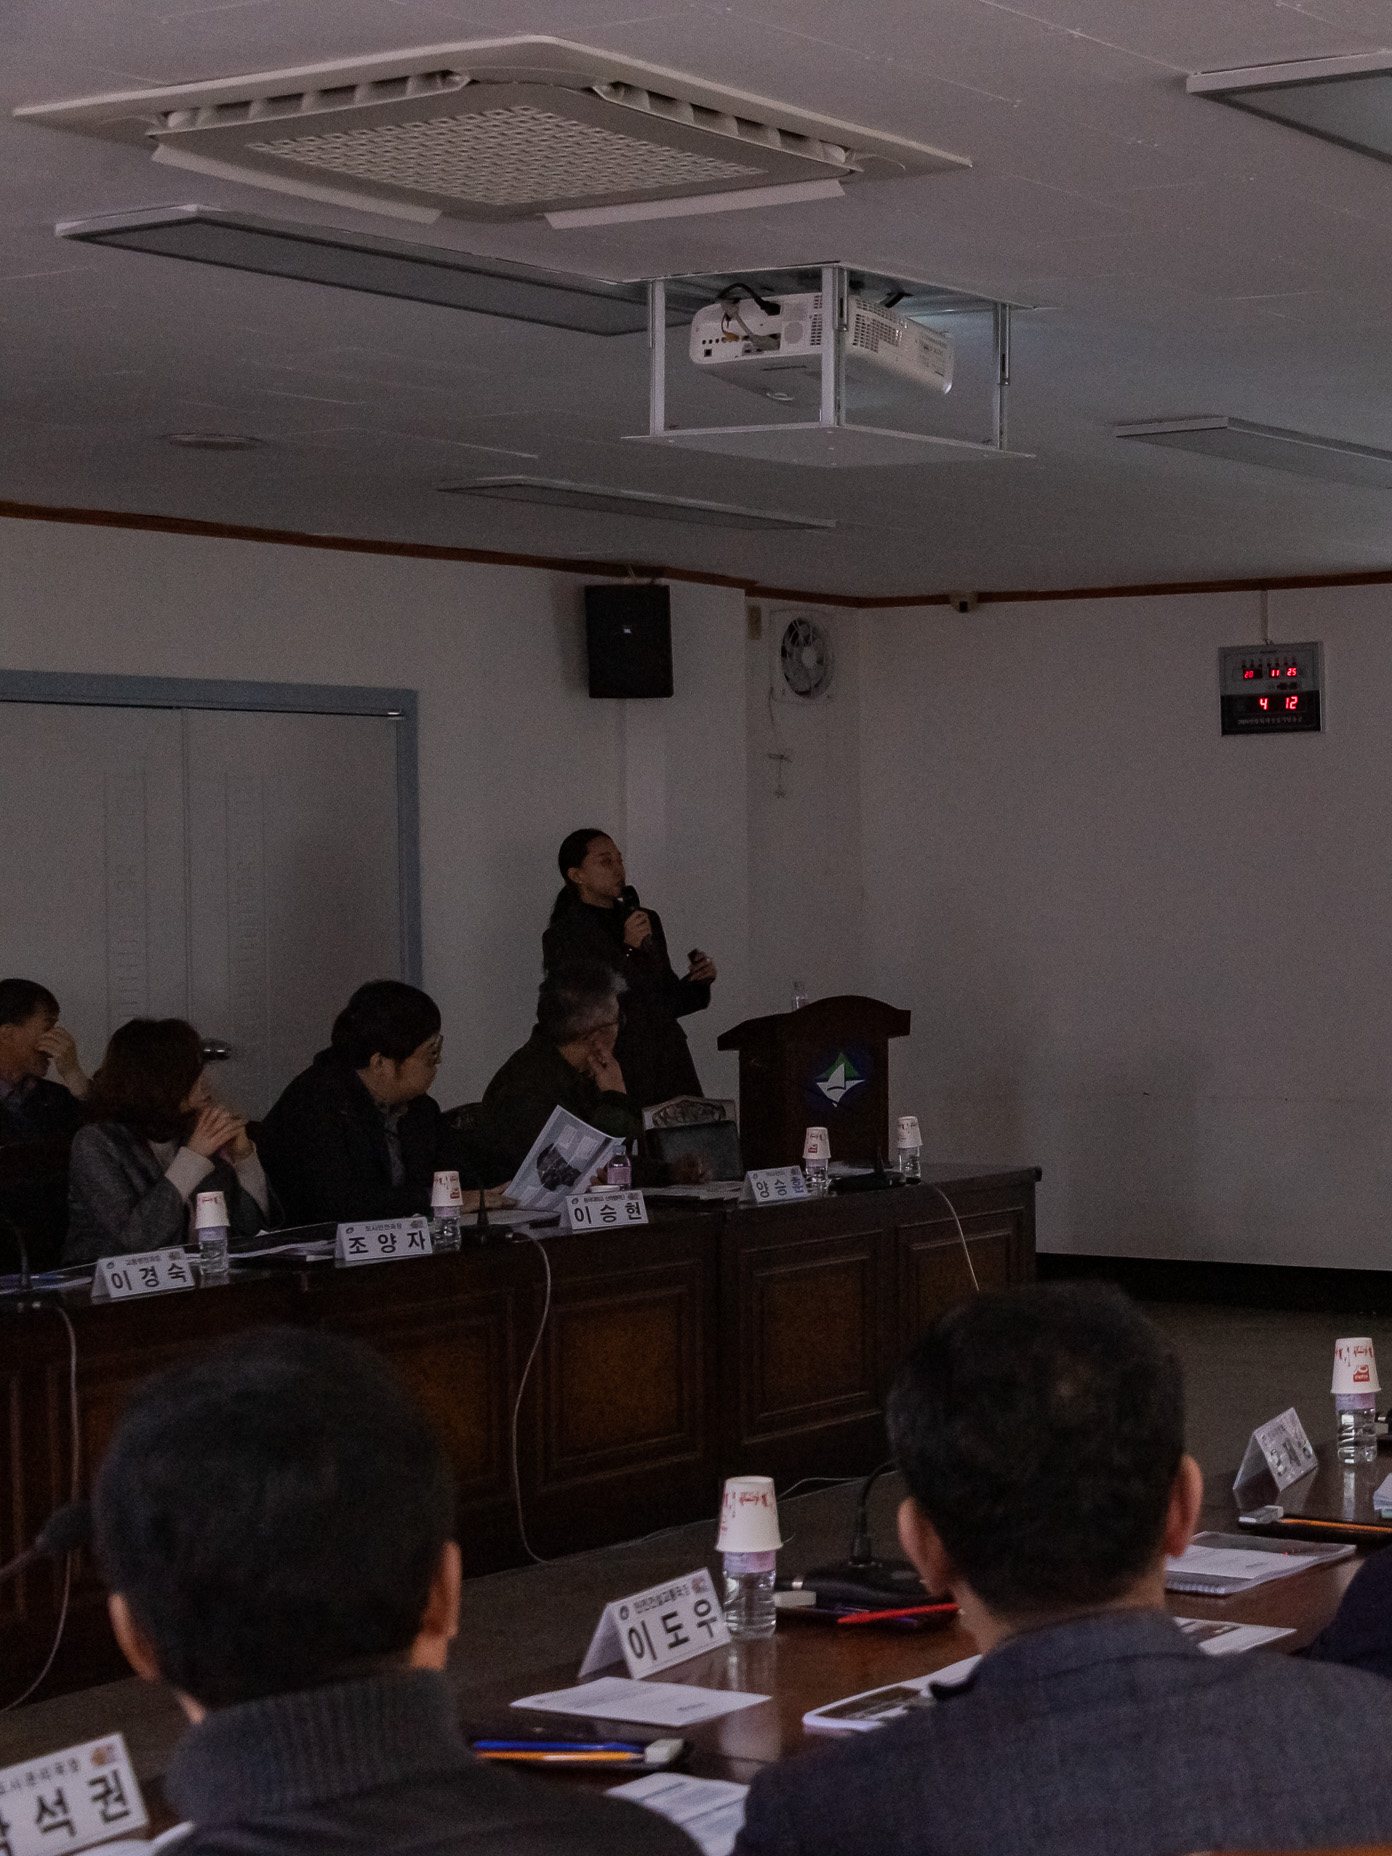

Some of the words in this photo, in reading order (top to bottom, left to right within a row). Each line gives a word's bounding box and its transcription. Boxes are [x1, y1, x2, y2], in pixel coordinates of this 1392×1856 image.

[1271, 668, 1280, 678] 11
[1286, 667, 1298, 677] 25
[1259, 697, 1269, 711] 4
[1285, 695, 1299, 710] 12
[574, 1201, 643, 1225] 이승현
[348, 1229, 426, 1255] 조양자
[111, 1262, 187, 1291] 이경숙
[628, 1598, 718, 1661] 이도우
